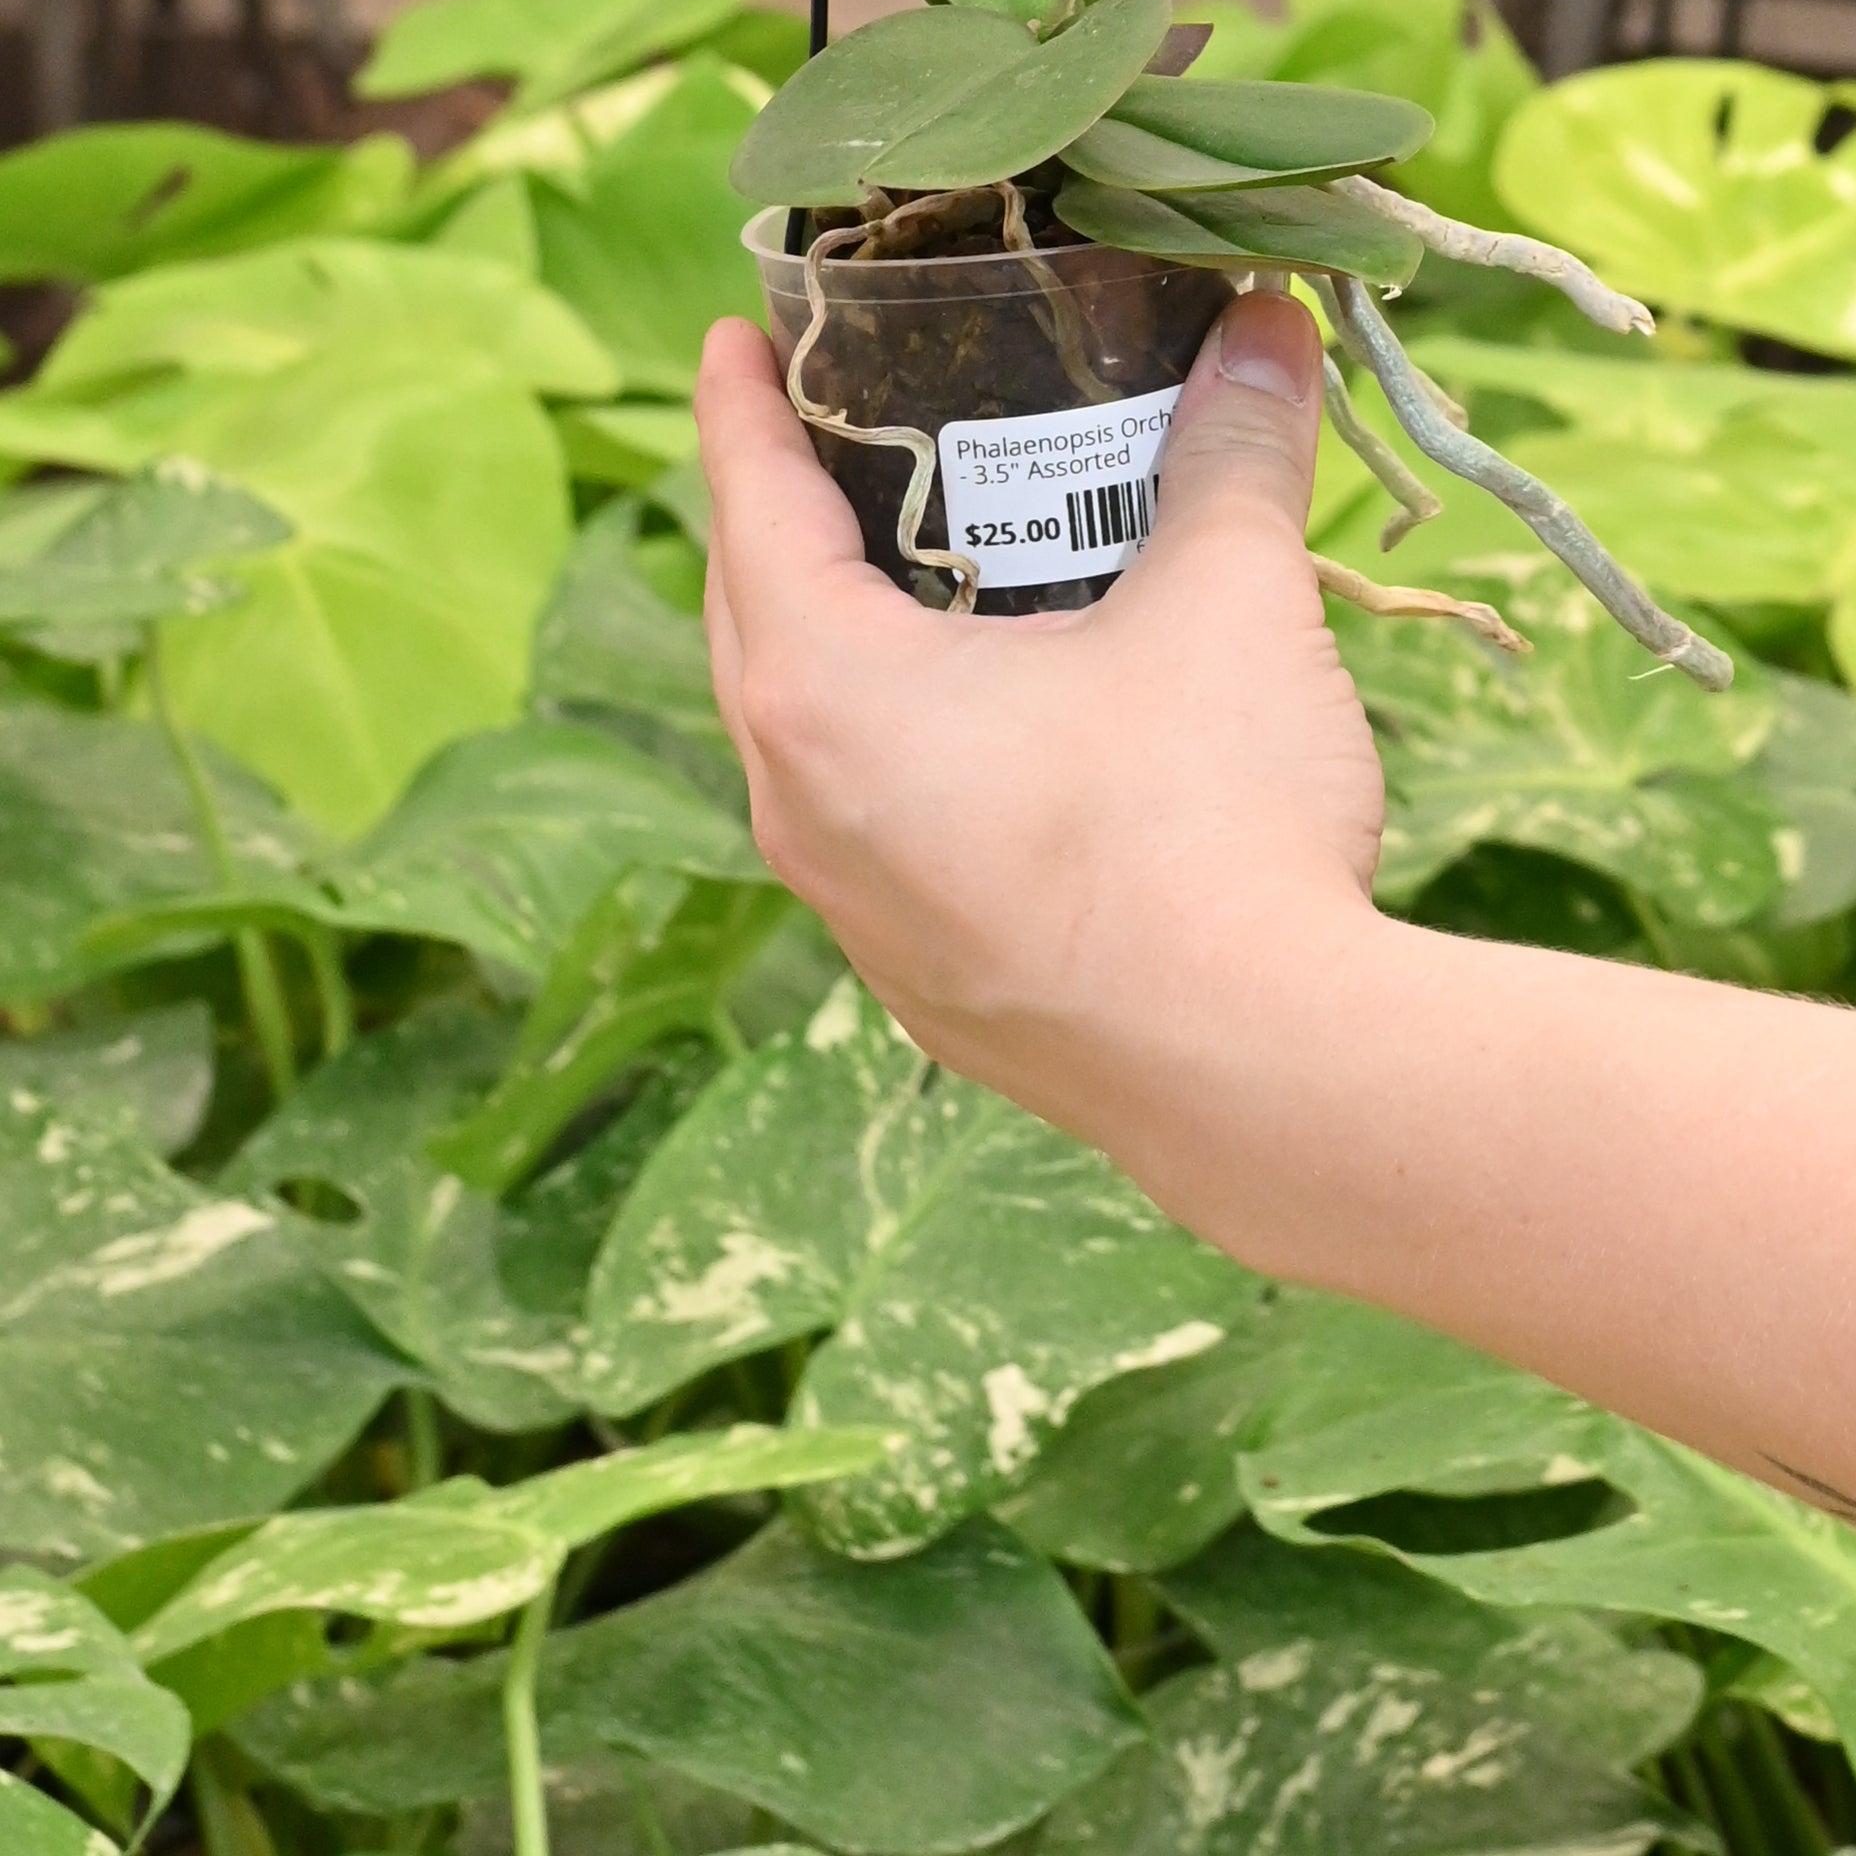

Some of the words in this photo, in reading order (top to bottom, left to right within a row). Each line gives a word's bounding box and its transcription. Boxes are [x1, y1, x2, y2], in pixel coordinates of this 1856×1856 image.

[956, 424, 1114, 460] Phalaenopsis
[1121, 405, 1176, 438] Orch
[974, 463, 1020, 485] 3.5"
[1028, 443, 1131, 480] Assorted
[965, 517, 1061, 548] $25.00
